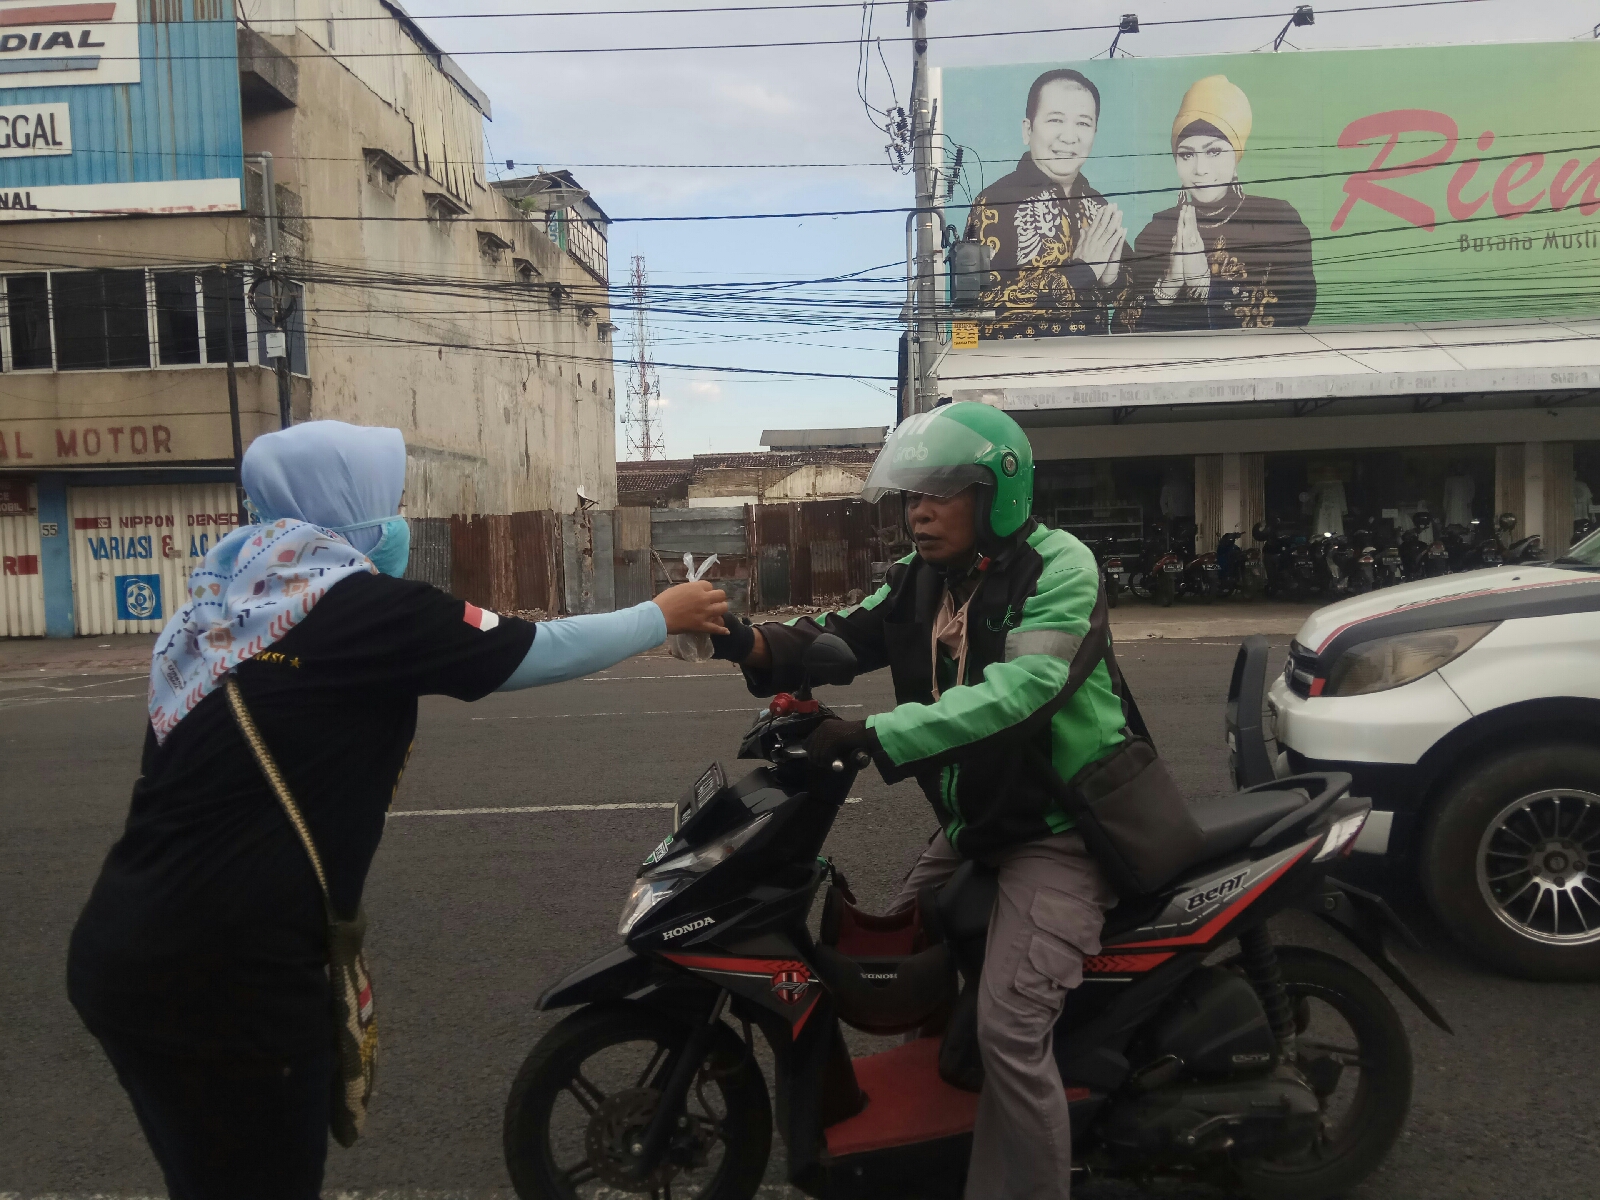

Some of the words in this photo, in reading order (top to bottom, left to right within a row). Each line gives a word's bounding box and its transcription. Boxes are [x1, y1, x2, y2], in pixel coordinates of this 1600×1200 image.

[0, 30, 105, 52] DIAL
[1460, 233, 1533, 252] Busana
[1072, 389, 1109, 404] Audio
[55, 424, 172, 458] MOTOR
[0, 502, 23, 512] OBIL
[119, 514, 175, 528] NIPPON
[187, 513, 239, 527] DENSO
[42, 525, 57, 537] 55
[88, 534, 153, 560] VARIASI
[161, 534, 174, 559] &
[662, 915, 716, 941] HONDA
